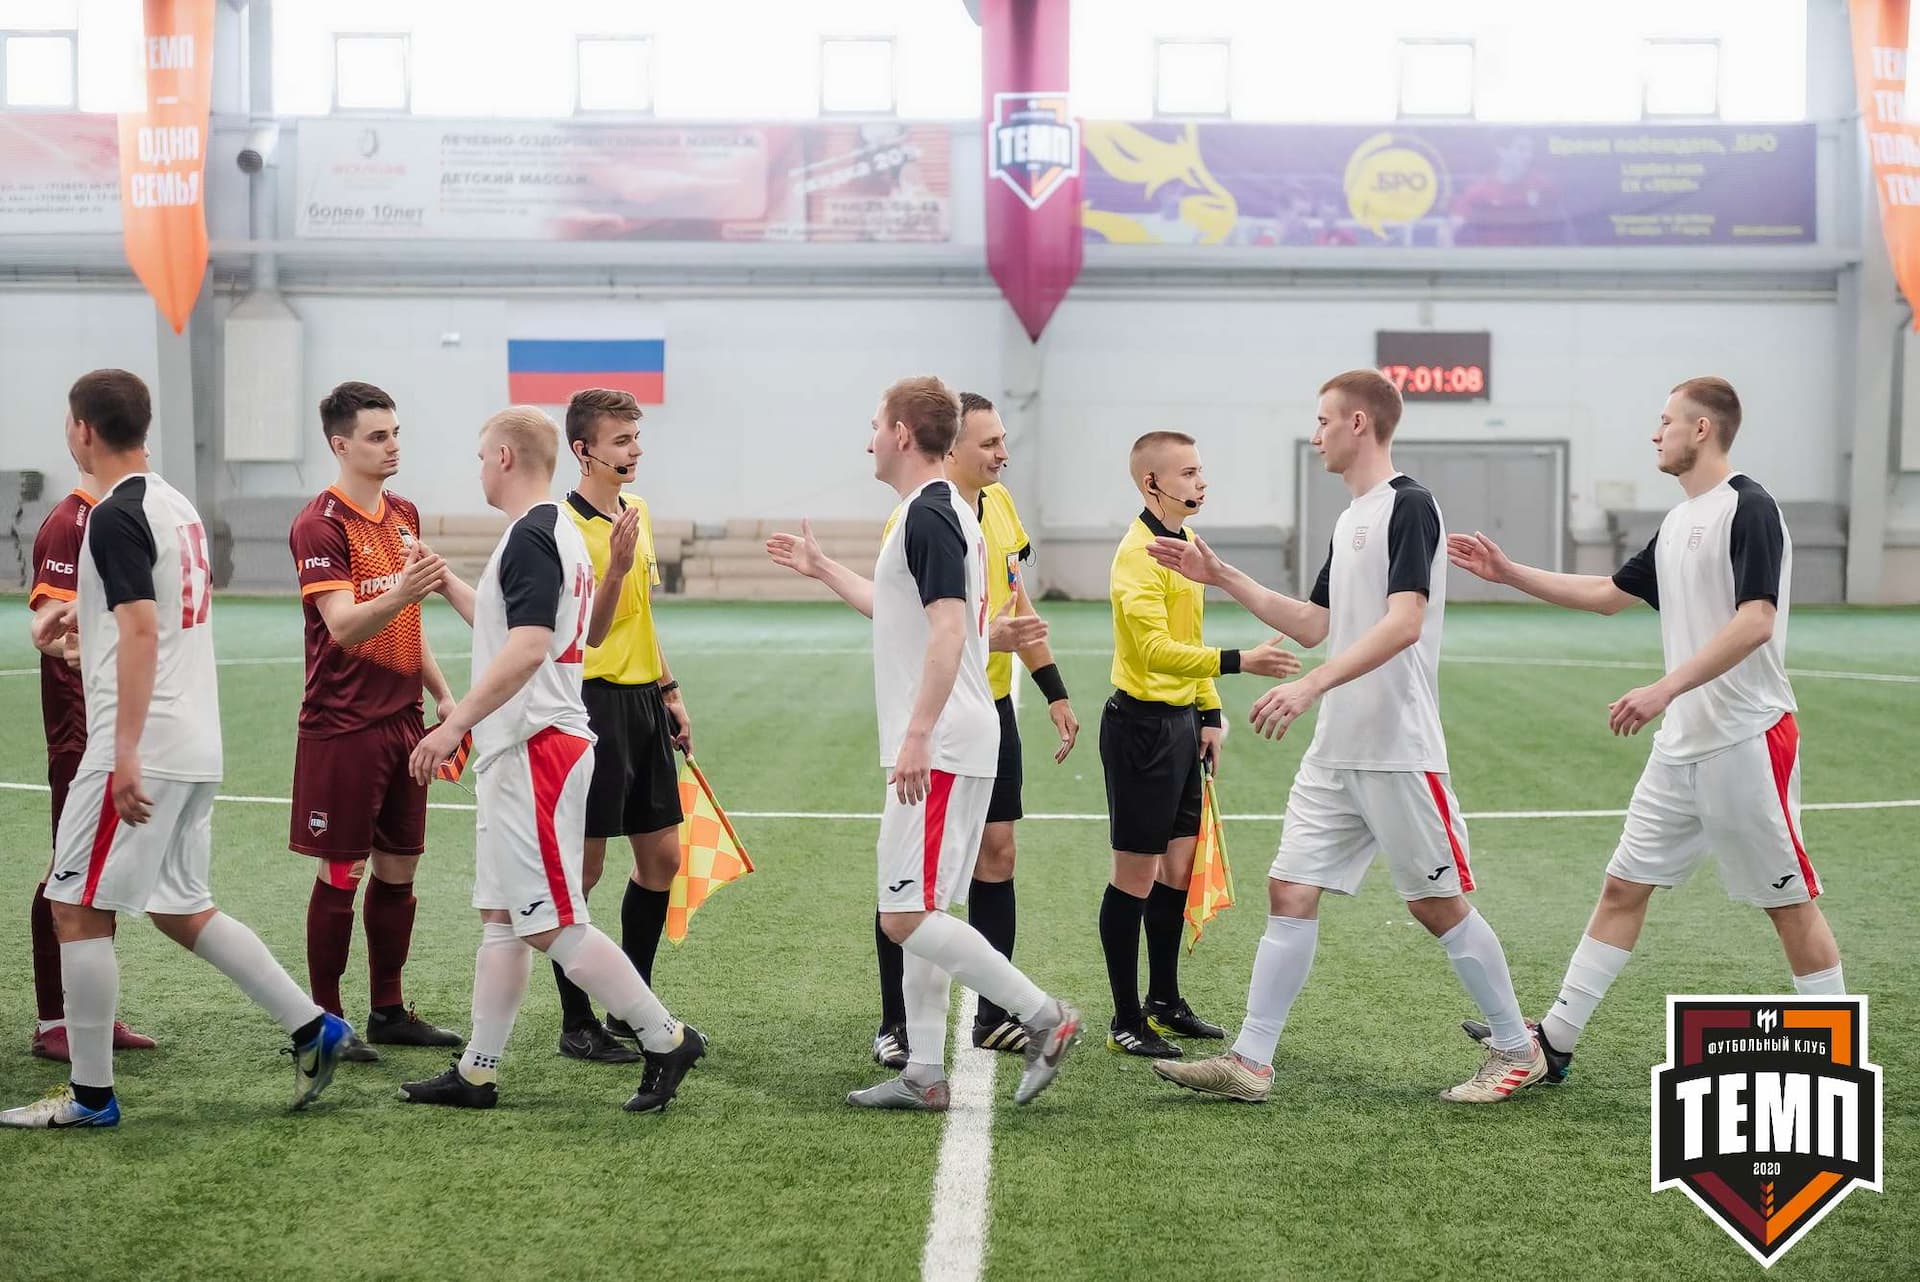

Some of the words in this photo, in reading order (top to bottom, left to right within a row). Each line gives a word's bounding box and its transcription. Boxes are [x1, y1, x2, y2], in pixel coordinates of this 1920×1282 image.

[138, 126, 199, 166] ОДНА
[440, 171, 514, 185] ДЕТСКИЙ
[131, 170, 200, 208] СЕМЬЯ
[308, 201, 365, 219] более
[46, 558, 75, 575] ПСБ
[305, 556, 332, 570] ПСБ
